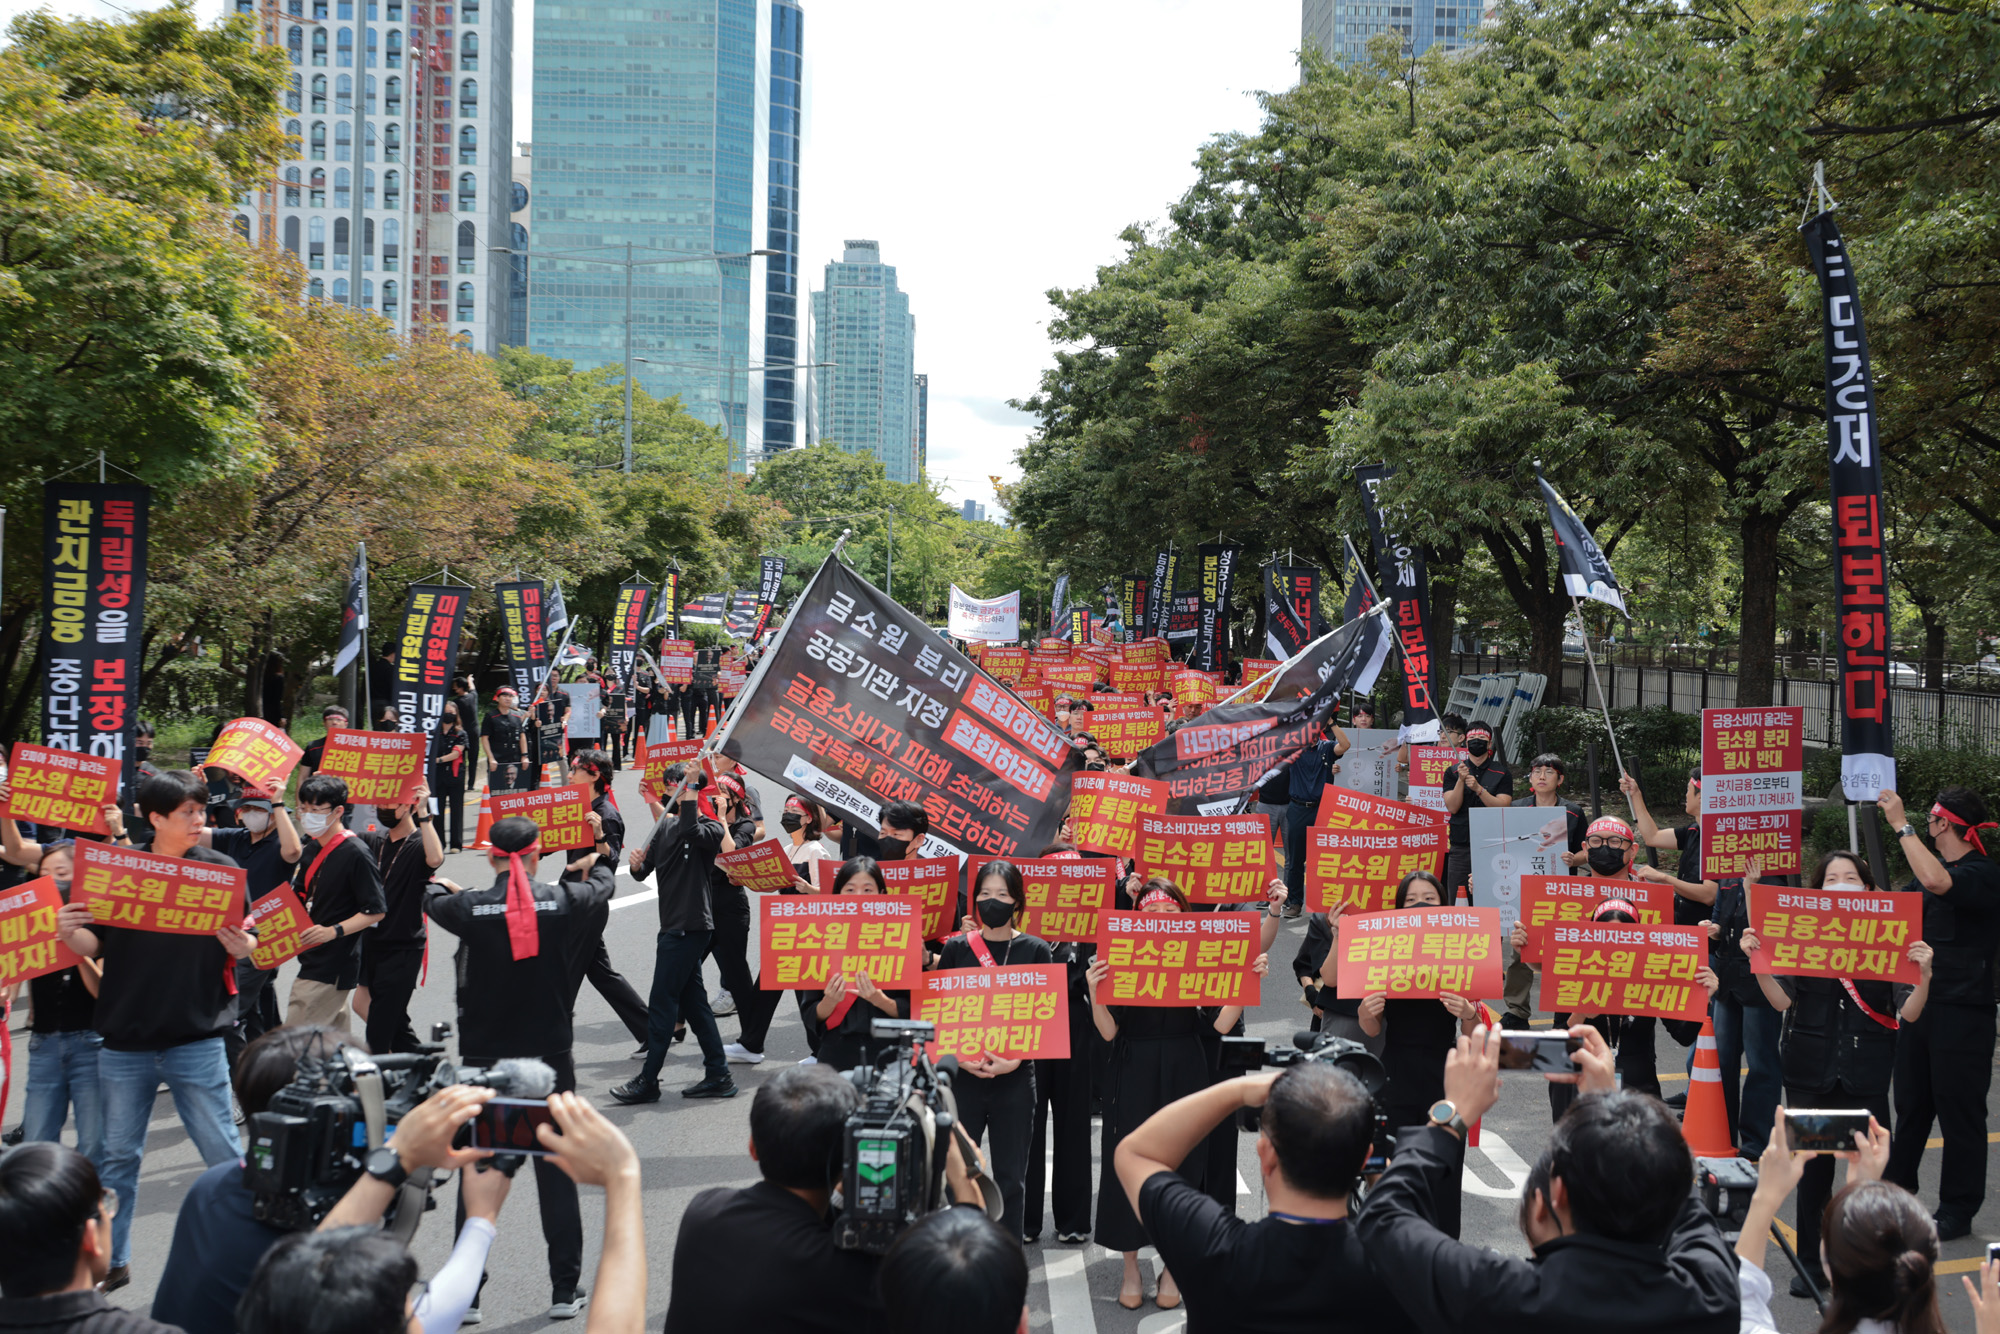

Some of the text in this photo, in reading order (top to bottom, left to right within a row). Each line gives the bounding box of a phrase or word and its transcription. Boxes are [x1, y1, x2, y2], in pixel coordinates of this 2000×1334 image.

[51, 499, 93, 643] 관치금융
[96, 500, 136, 643] 독립성을
[613, 589, 634, 645] 독립없는
[1124, 581, 1135, 626] 관치금융
[1202, 556, 1218, 671] 분리형 감독기구
[1837, 495, 1887, 724] 퇴보한다
[502, 589, 527, 661] 독립없는
[522, 588, 545, 660] 미래없는
[625, 589, 646, 646] 미래없는
[977, 615, 1005, 623] 중단하라
[399, 593, 436, 682] 독립없는
[424, 595, 460, 685] 미래없는
[983, 657, 1026, 667] 금융소비자
[1125, 647, 1156, 658] 금소원 분리
[1399, 599, 1430, 710] 퇴보한다
[825, 591, 909, 654] 금소원
[912, 645, 968, 693] 분리
[966, 682, 1065, 760] 철회하라!
[1075, 672, 1093, 682] 분리
[1113, 671, 1161, 681] 금융소비자
[1117, 682, 1157, 692] 보호하자!
[1175, 679, 1214, 694] 금소원 분리
[805, 629, 900, 700] 공공기관
[896, 685, 950, 729] 지정
[950, 718, 1048, 794] 철회하라!
[1092, 711, 1154, 721] 국제기준에 부합하는
[1712, 712, 1793, 728] 금융소비자 울리는
[236, 721, 265, 734] 자리만
[264, 729, 291, 752] 늘리는
[1089, 720, 1159, 739] 금감원 독립성
[1717, 729, 1789, 749] 금소원 분리
[245, 737, 288, 769] 분리
[370, 737, 412, 750] 부합하는
[661, 745, 698, 756] 자리만 늘리는
[785, 672, 900, 752] 금융소비자
[899, 740, 953, 787] 피해
[948, 772, 1031, 832] 초래하는
[1418, 749, 1456, 759] 금융소비자
[20, 749, 107, 776] 모피아 자리만 늘리는
[323, 749, 418, 775] 금감원 독립성
[1723, 750, 1783, 770] 결사 반대
[10, 766, 108, 802] 금소원 분리
[769, 705, 1018, 858] 금융감독원 해체 중단하라!
[1074, 777, 1152, 798] 국제기준에 부합하는
[1716, 777, 1789, 792] 관치금융으로부터
[9, 792, 96, 826] 반대한다!
[500, 791, 579, 810] 모피아 자리만 늘리는
[814, 776, 874, 818] 금융감독원
[1336, 794, 1371, 813] 모피아
[1374, 804, 1406, 821] 자리만
[1408, 812, 1433, 827] 늘리는
[1709, 792, 1795, 809] 금융소비자 지켜내자
[552, 803, 583, 825] 분리
[1143, 819, 1265, 836] 금융소비자보호 역행하는
[1716, 814, 1789, 831] 실익 없는 쪼개기
[1316, 833, 1438, 849] 금융소비자보호 역행하는
[1599, 822, 1626, 835] 분리 반대
[726, 846, 773, 863] 자리만 늘리는
[1143, 838, 1266, 868] 금소원 분리
[1712, 832, 1792, 853] 금융소비자는
[84, 847, 236, 886] 금융소비자보호 역행하는
[753, 856, 783, 876] 분리
[913, 864, 946, 879] 늘리는
[1060, 865, 1107, 878] 역행하는
[1317, 851, 1438, 880] 금소원 분리
[1706, 855, 1747, 874] 피눈물
[82, 867, 233, 911] 금소원 분리
[1057, 883, 1106, 908] 분리
[1205, 871, 1264, 897] 반대!
[1321, 882, 1371, 909] 결사
[1545, 882, 1648, 902] 관치금융 막아내고
[87, 897, 226, 931] 결사 반대!
[770, 901, 912, 917] 금융소비자보호 역행하는
[1777, 894, 1894, 913] 관치금융 막아내고
[256, 907, 297, 942] 분리
[1040, 912, 1099, 937] 반대!
[1107, 917, 1250, 933] 금융소비자보호 역행하는
[1357, 913, 1480, 931] 국제기준에 부합하는
[1762, 912, 1909, 946] 금융소비자
[770, 922, 849, 950] 금소원
[858, 923, 911, 949] 분리
[1347, 933, 1490, 963] 금감원 독립성
[1554, 928, 1699, 948] 금융소비자보호 역행하는
[1107, 938, 1249, 968] 금소원 분리
[1553, 949, 1698, 981] 금소원 분리
[1772, 942, 1899, 975] 보호하자!
[776, 954, 905, 983] 결사 반대!
[928, 972, 1048, 991] 국제기준에 부합하는
[1364, 963, 1474, 992] 보장하라!
[1113, 971, 1243, 999] 결사 반대!
[1556, 981, 1690, 1011] 결사 반대!
[920, 992, 1057, 1024] 금감원 독립성
[937, 1025, 1040, 1056] 보장하라!
